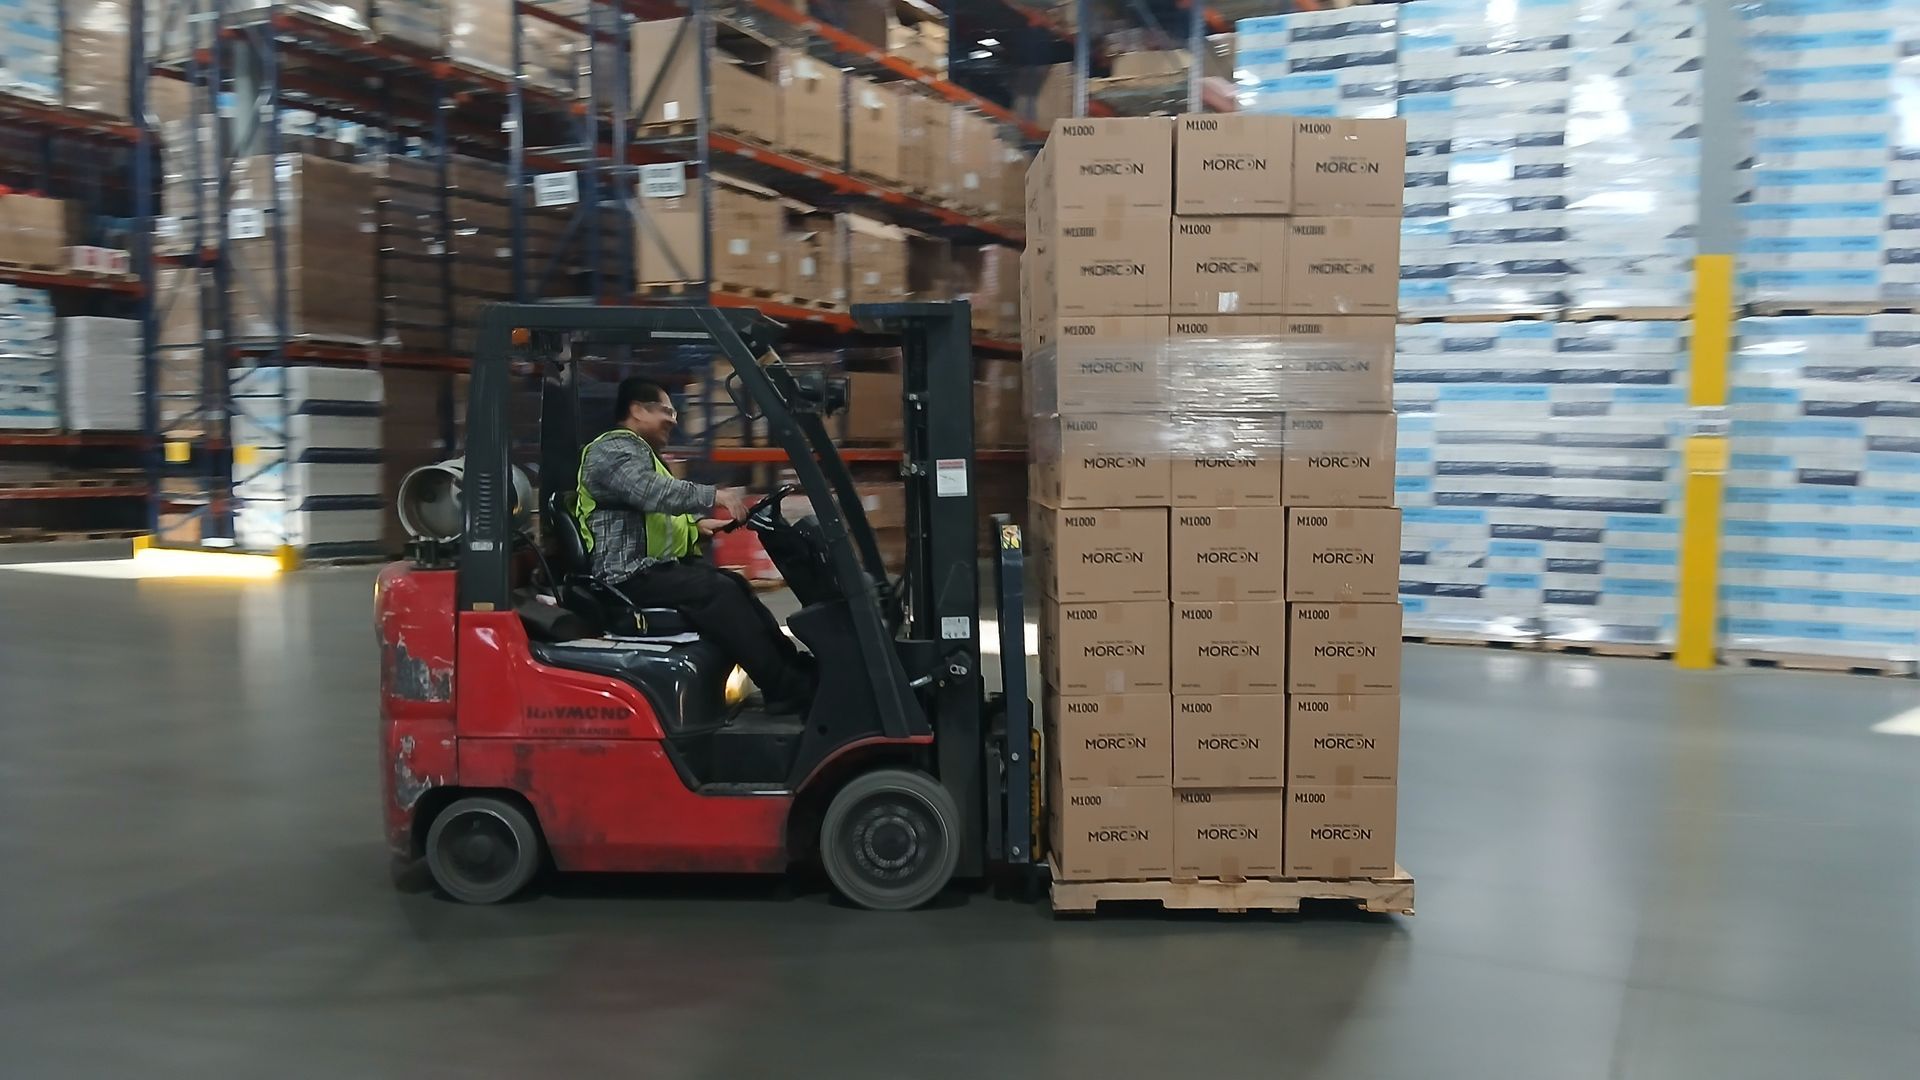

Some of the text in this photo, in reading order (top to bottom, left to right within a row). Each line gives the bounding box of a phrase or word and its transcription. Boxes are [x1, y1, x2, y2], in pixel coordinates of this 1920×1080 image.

[1063, 125, 1094, 136] M1000
[1186, 120, 1217, 131] M1000
[1300, 123, 1331, 134] M1000
[1203, 158, 1266, 171] MORCON
[1316, 161, 1378, 173] MORCON
[1180, 223, 1210, 235] M1000
[1064, 325, 1095, 335] M1000
[1177, 323, 1208, 333] M1000
[1084, 457, 1145, 469] MORCON
[1309, 456, 1370, 468] MORCON
[1065, 517, 1096, 527] M1000
[1180, 516, 1210, 527] M1000
[1297, 516, 1328, 527] M1000
[1082, 552, 1143, 564] MORCON
[1197, 552, 1258, 563] MORCON
[1312, 552, 1374, 564] MORCON
[1067, 610, 1097, 620] M1000
[1182, 609, 1212, 620] M1000
[1299, 609, 1329, 620] M1000
[1084, 645, 1145, 657] MORCON
[1199, 645, 1259, 656] MORCON
[1314, 645, 1375, 657] MORCON
[1068, 702, 1099, 713] M1000
[1182, 702, 1212, 713] M1000
[1298, 701, 1329, 712] M1000
[1085, 737, 1146, 749] MORCON
[1198, 738, 1259, 750] MORCON
[1314, 738, 1375, 750] MORCON
[1071, 796, 1101, 805] M1000
[1181, 793, 1211, 804] M1000
[1295, 793, 1325, 804] M1000
[1088, 829, 1148, 842] MORCON
[1198, 828, 1258, 840] MORCON
[1311, 828, 1371, 840] MORCON
